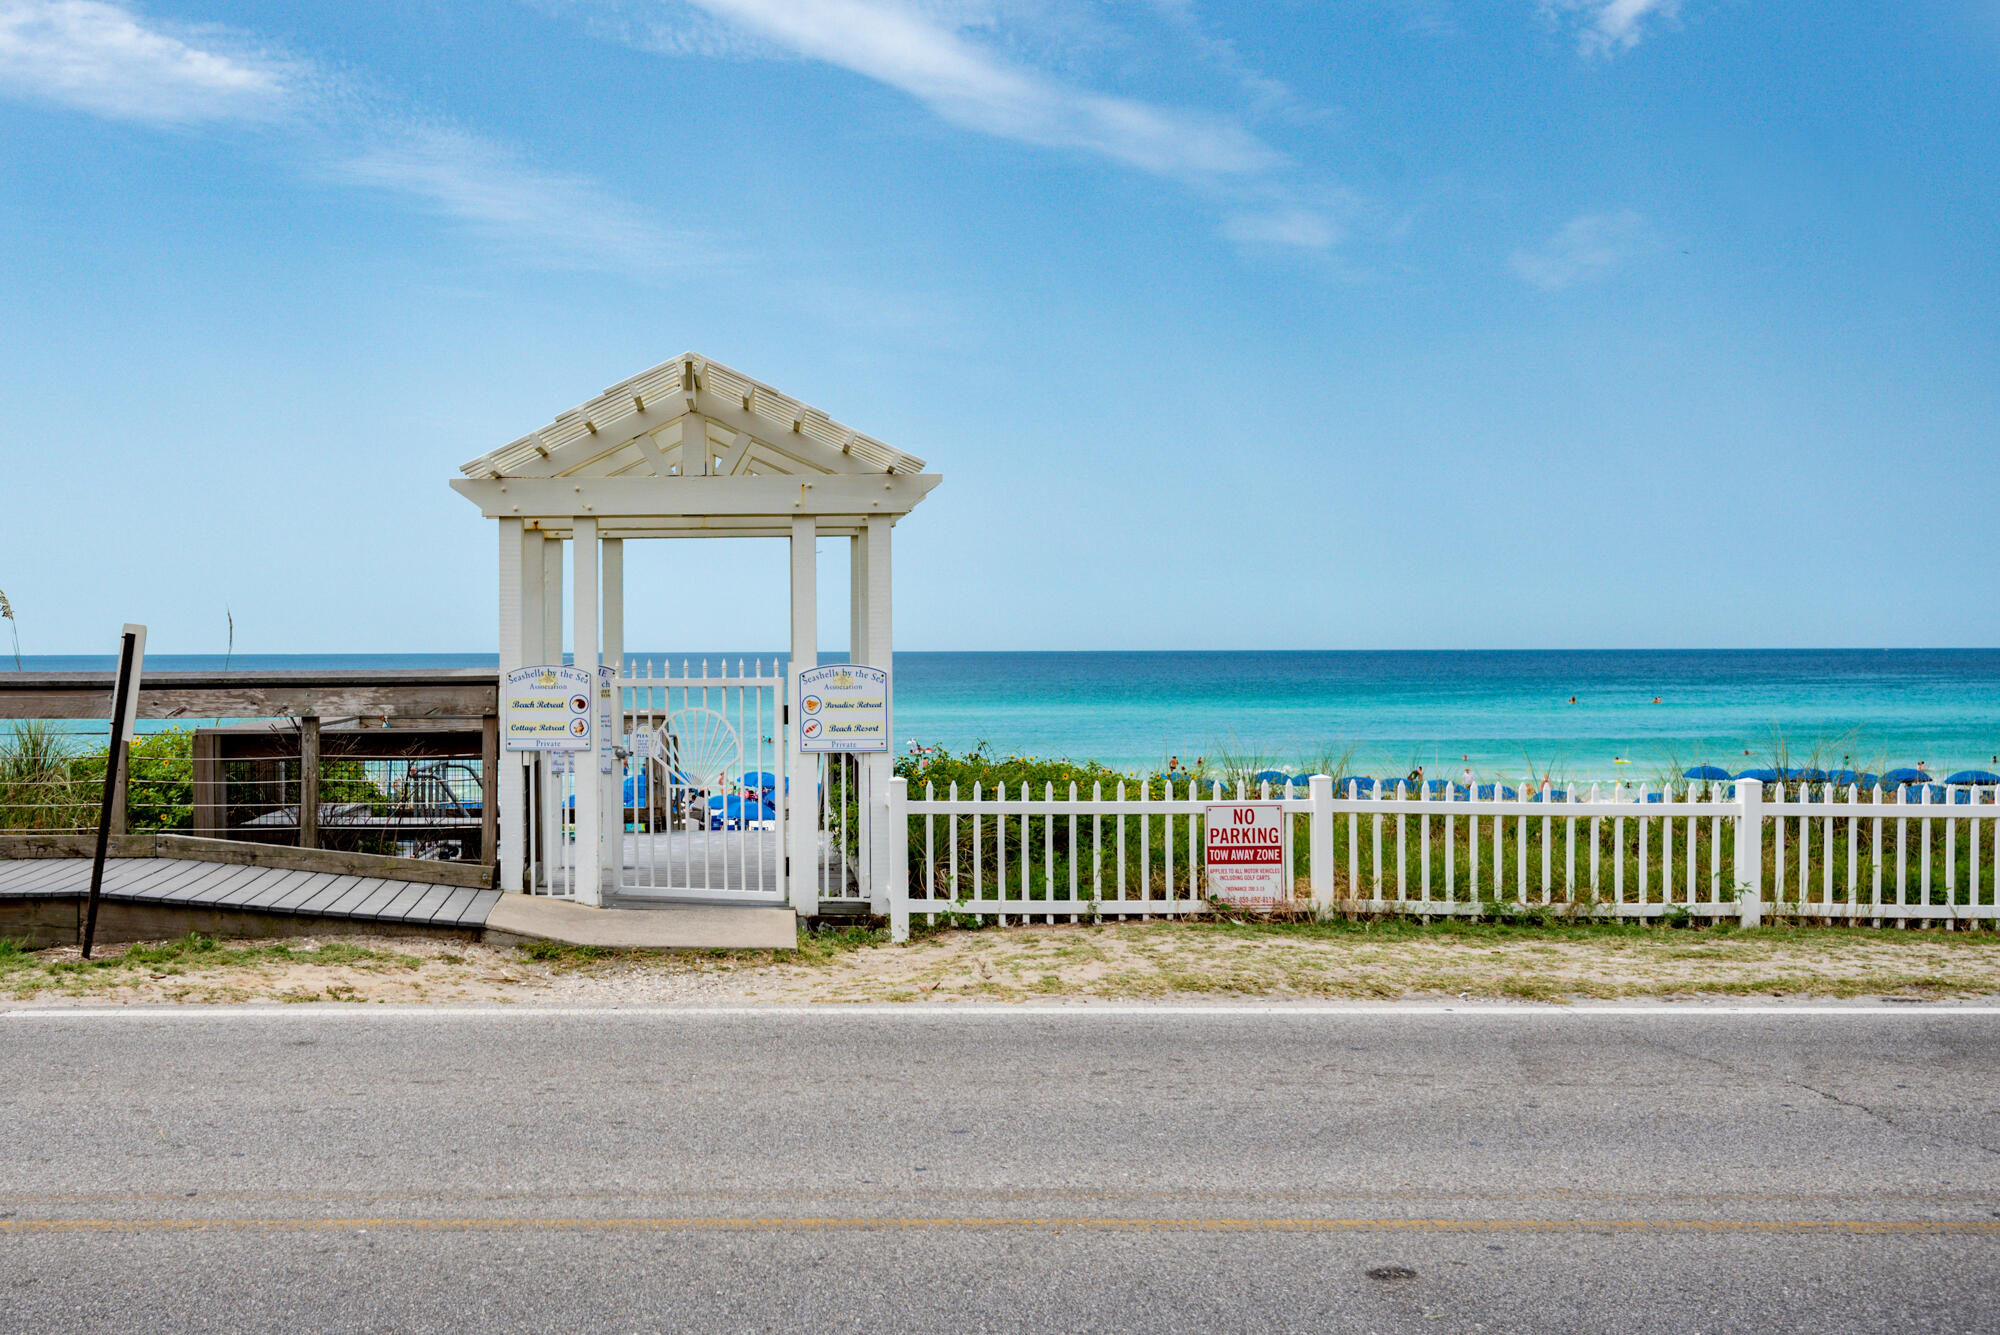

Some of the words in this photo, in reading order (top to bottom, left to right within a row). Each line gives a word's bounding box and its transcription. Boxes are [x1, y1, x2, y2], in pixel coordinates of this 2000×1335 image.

[508, 668, 544, 684] Seashells
[547, 668, 557, 678] by
[560, 669, 573, 679] the
[575, 672, 589, 684] Sea
[802, 668, 839, 685] Seashells
[842, 668, 852, 678] by
[855, 669, 868, 679] the
[871, 672, 885, 684] Sea
[512, 700, 535, 709] Beach
[536, 700, 564, 709] Retreat
[825, 701, 855, 709] Paradise
[856, 701, 882, 709] Retreat
[511, 724, 537, 732] Cottage
[829, 724, 852, 732] Beach
[853, 724, 879, 732] Resort
[1233, 808, 1255, 825] NO
[1210, 827, 1279, 844] PARKING
[1209, 849, 1229, 861] TOW
[1230, 849, 1255, 861] AWAY
[1256, 849, 1280, 860] ZONE
